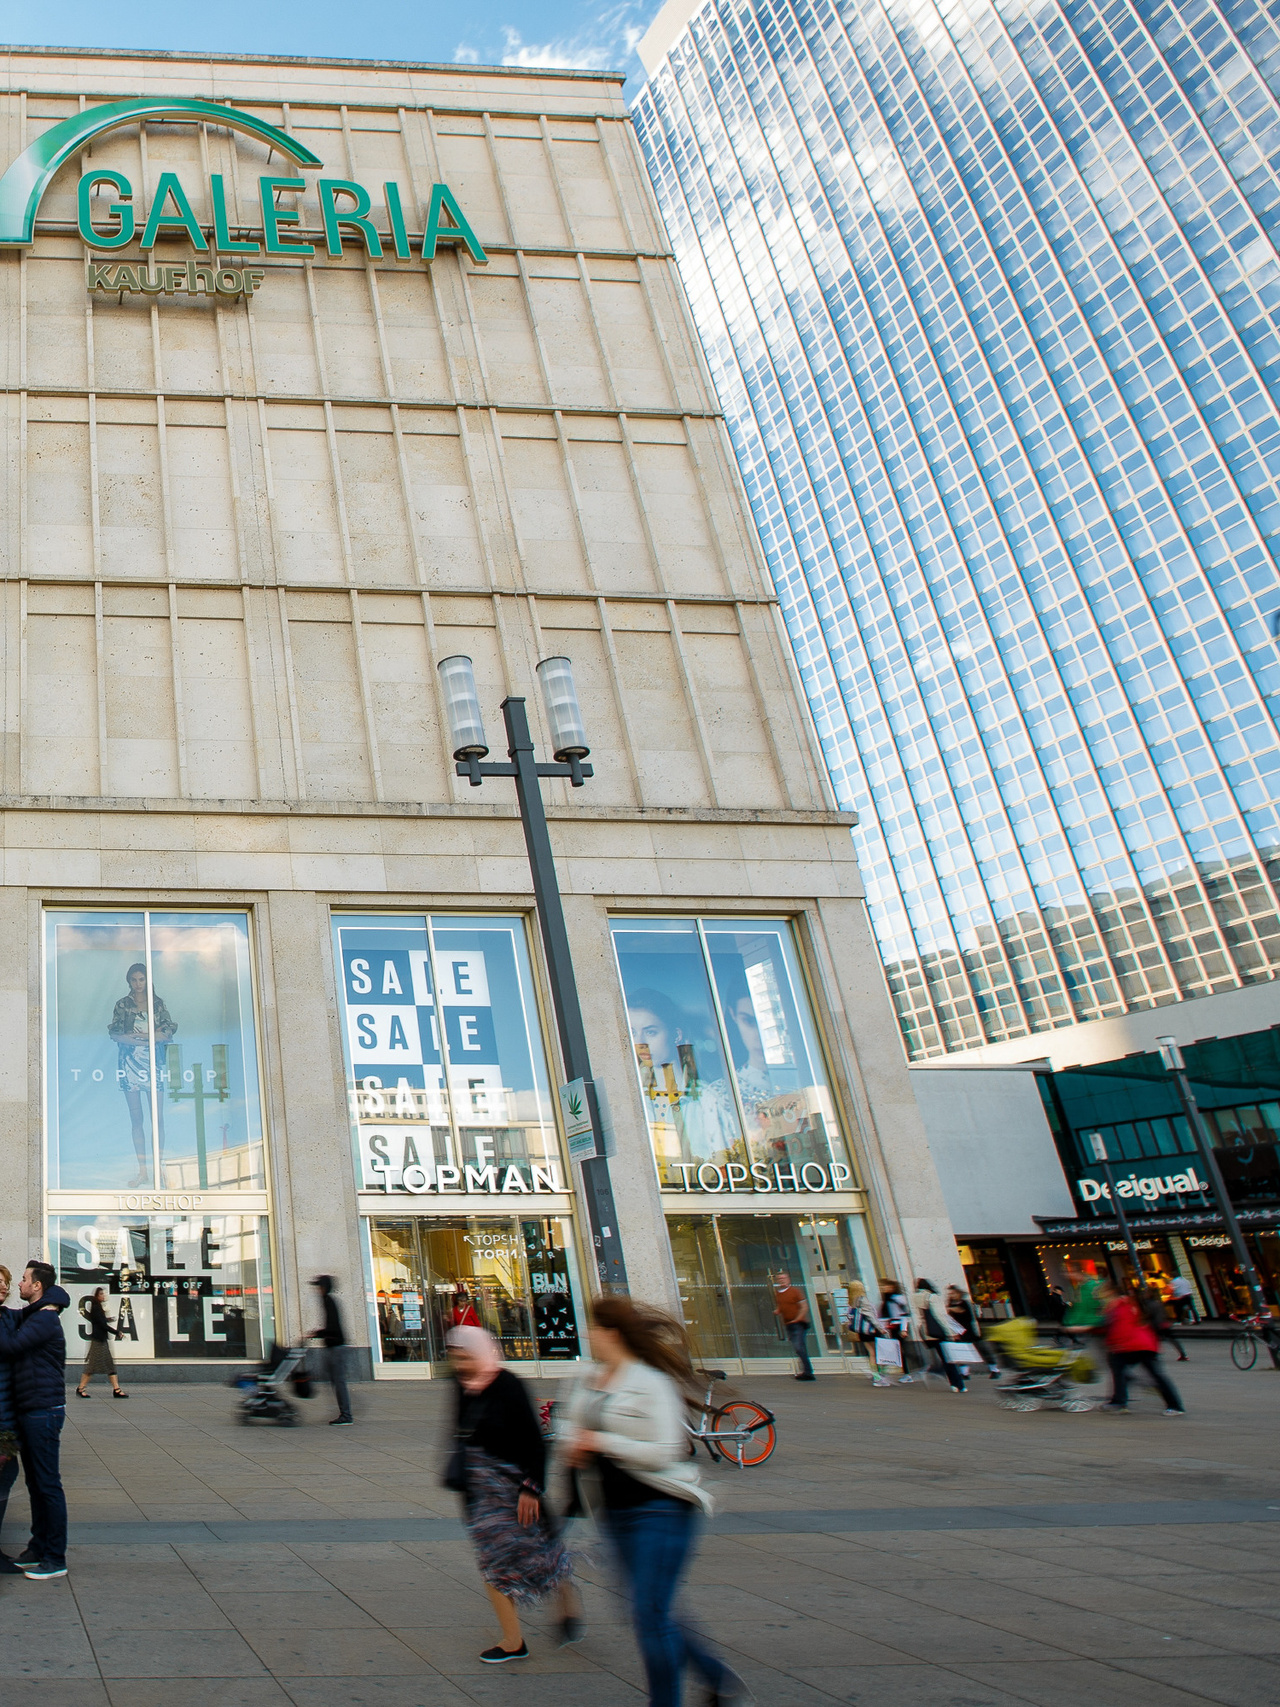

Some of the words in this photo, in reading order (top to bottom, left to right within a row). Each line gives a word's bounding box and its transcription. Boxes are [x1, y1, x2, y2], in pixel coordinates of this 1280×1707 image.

[76, 169, 490, 267] GALERIA
[350, 958, 473, 995] SALE
[357, 1013, 482, 1051] SALE
[71, 1069, 218, 1083] TOPSHOP
[373, 1164, 561, 1194] TOPMAN
[670, 1162, 851, 1192] TOPSHOP
[114, 1195, 203, 1210] TOPSHOP
[77, 1225, 223, 1270] SALE
[136, 1281, 150, 1289] TO
[183, 1281, 203, 1289] OFF
[531, 1272, 567, 1288] BLN
